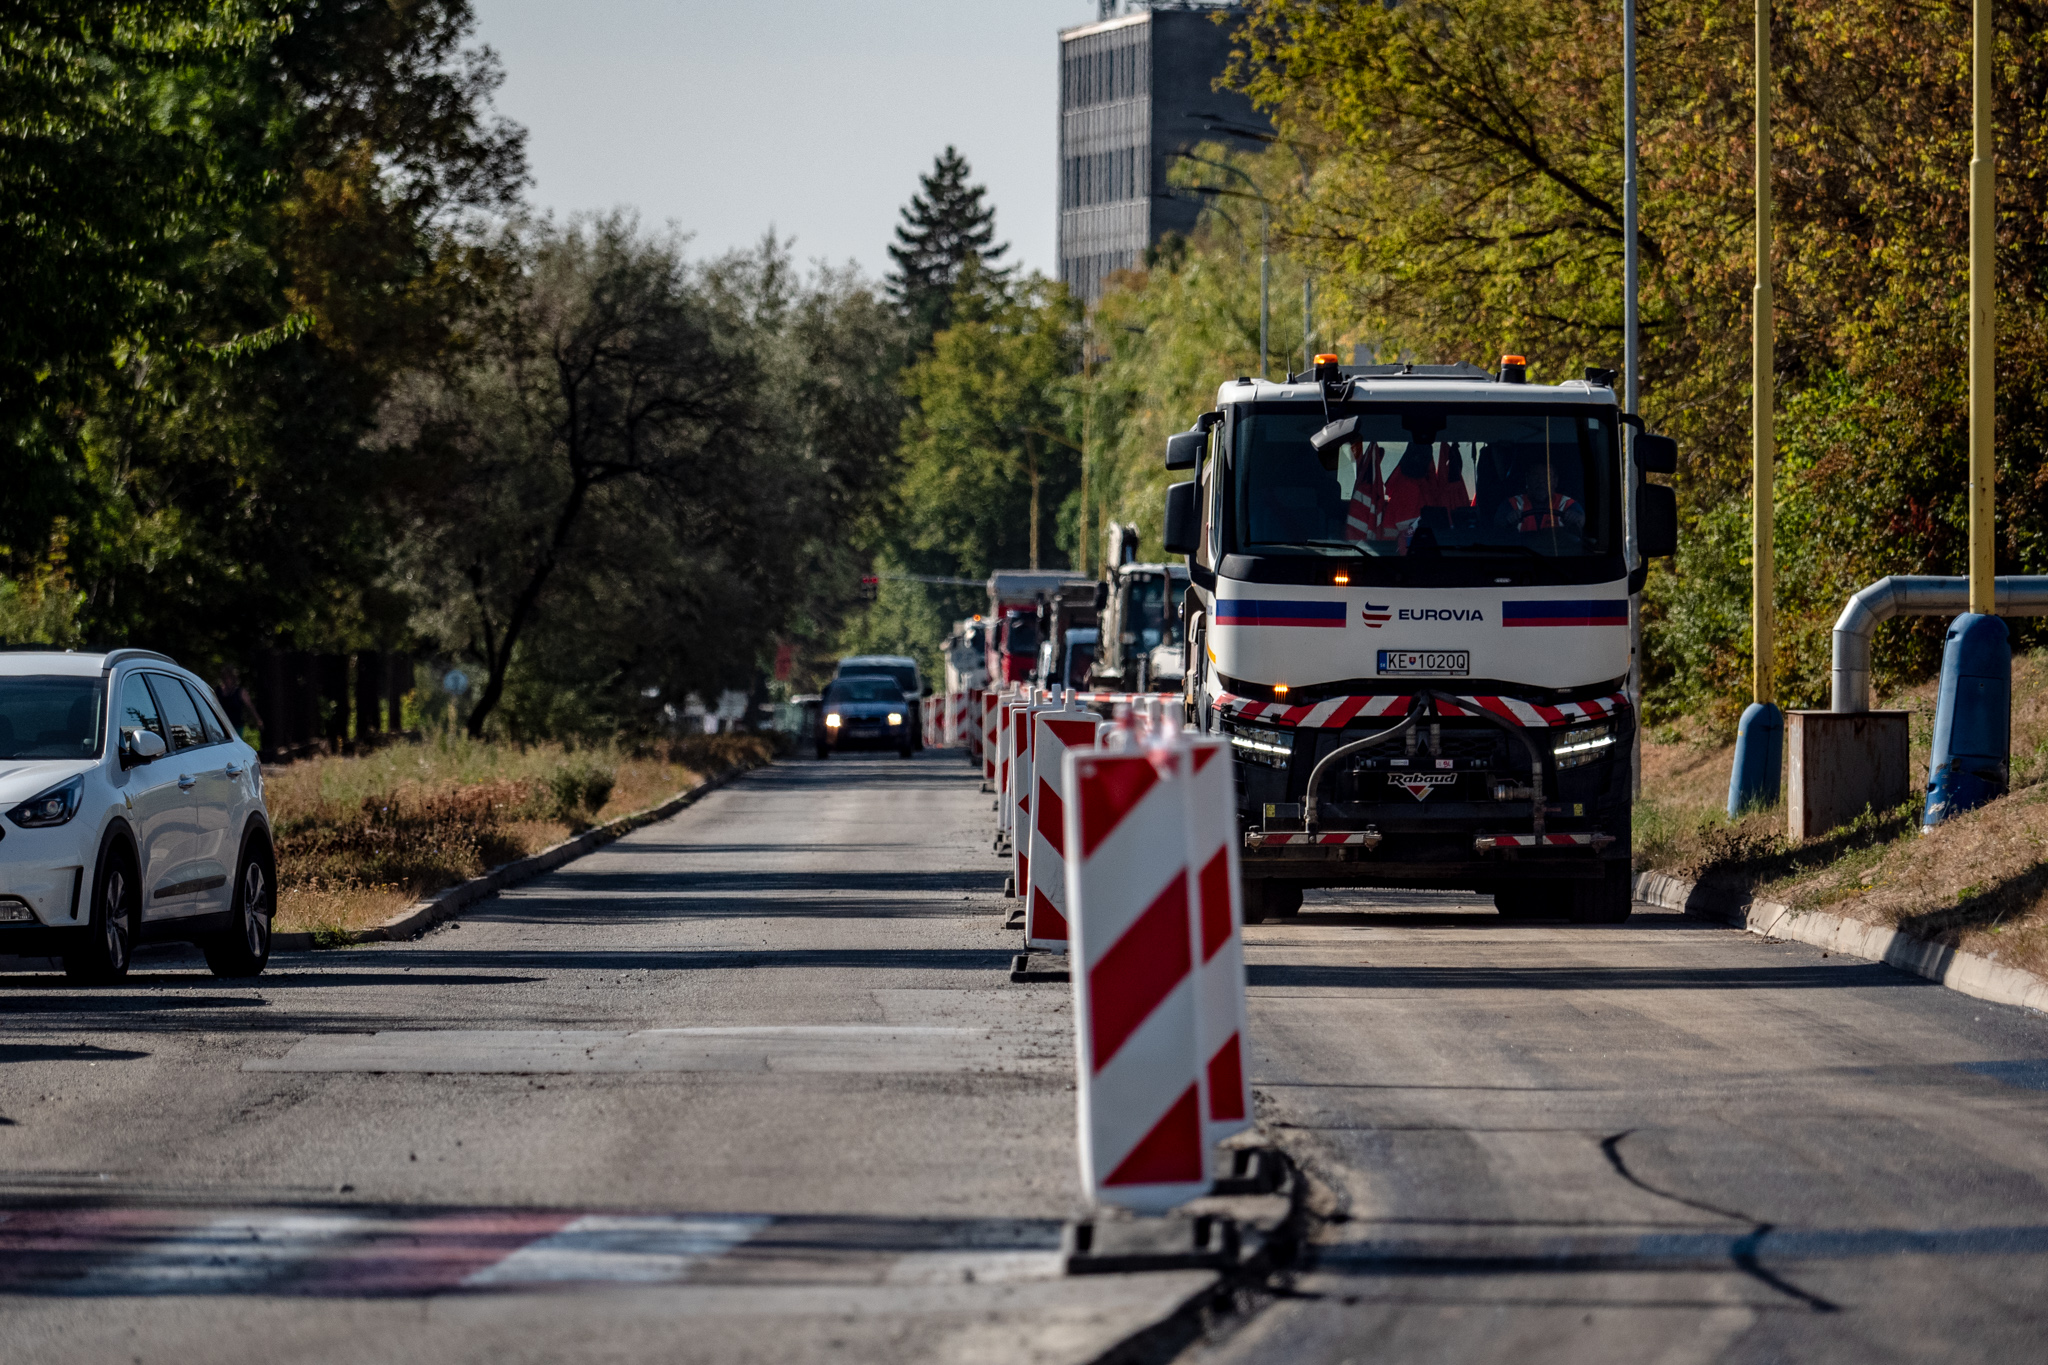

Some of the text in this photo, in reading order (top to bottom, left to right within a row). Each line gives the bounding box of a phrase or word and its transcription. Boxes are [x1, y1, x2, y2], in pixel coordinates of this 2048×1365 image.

[1399, 609, 1484, 621] EUROVIA
[1388, 653, 1407, 668] KE
[1388, 773, 1457, 787] Rabaud
